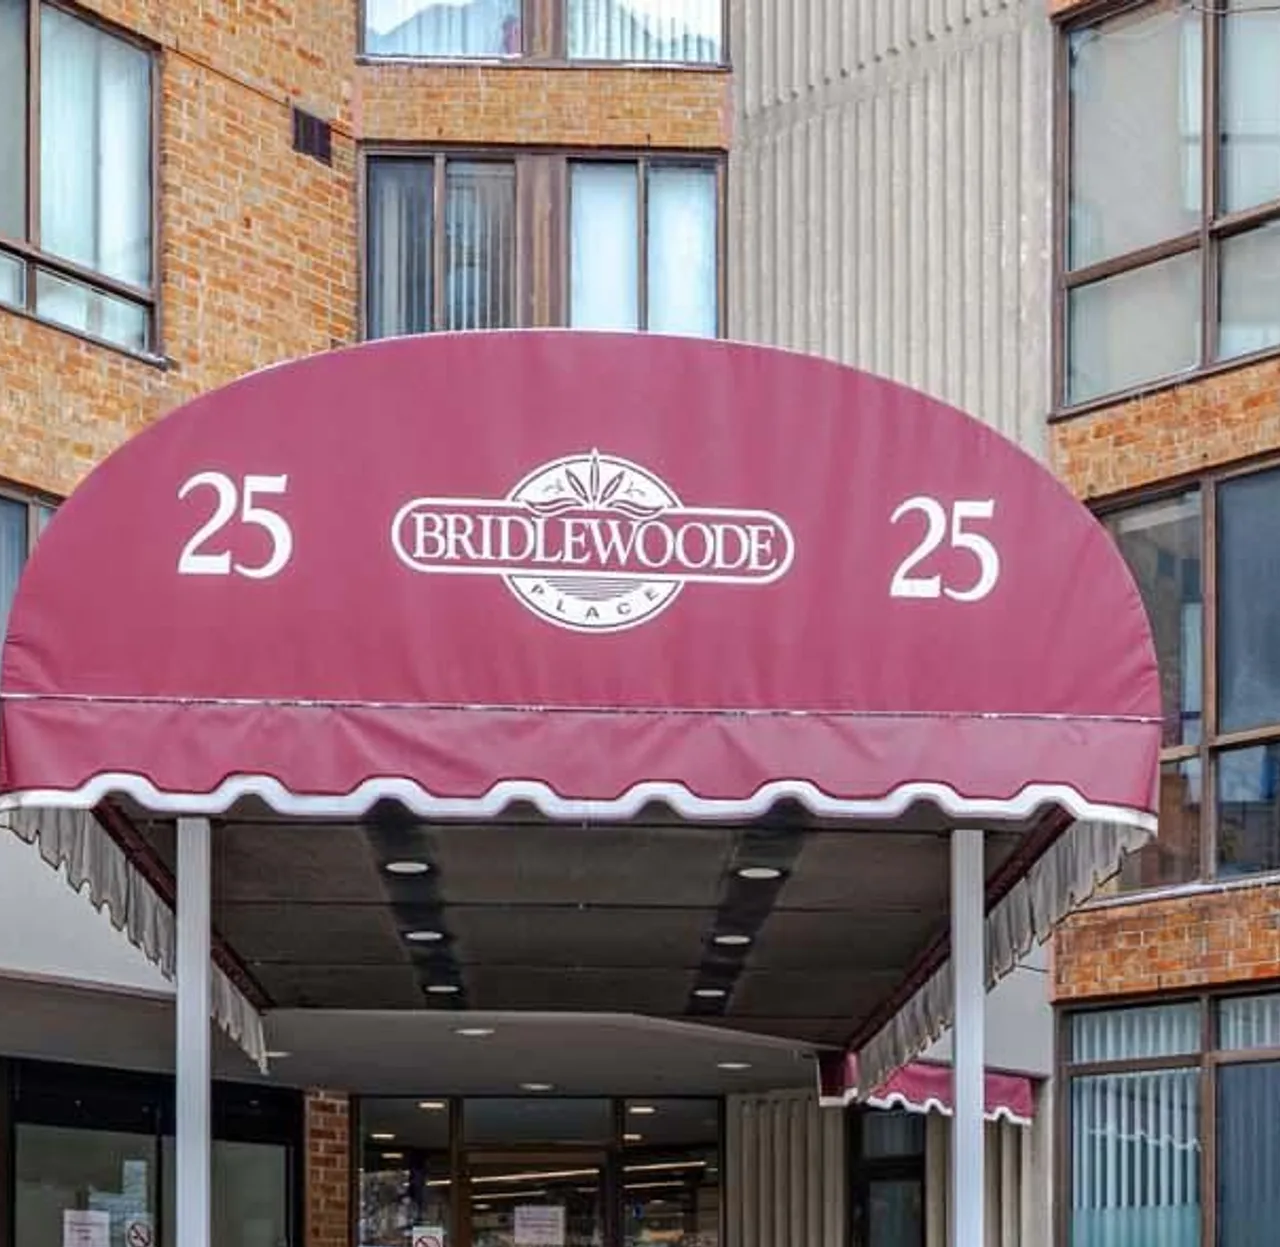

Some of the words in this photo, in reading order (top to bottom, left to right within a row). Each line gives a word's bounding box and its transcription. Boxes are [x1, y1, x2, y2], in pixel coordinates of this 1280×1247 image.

[178, 472, 293, 579] 25
[412, 512, 778, 569] BRIDLEWOODE
[890, 497, 999, 601] 25
[531, 583, 657, 619] PLACE
